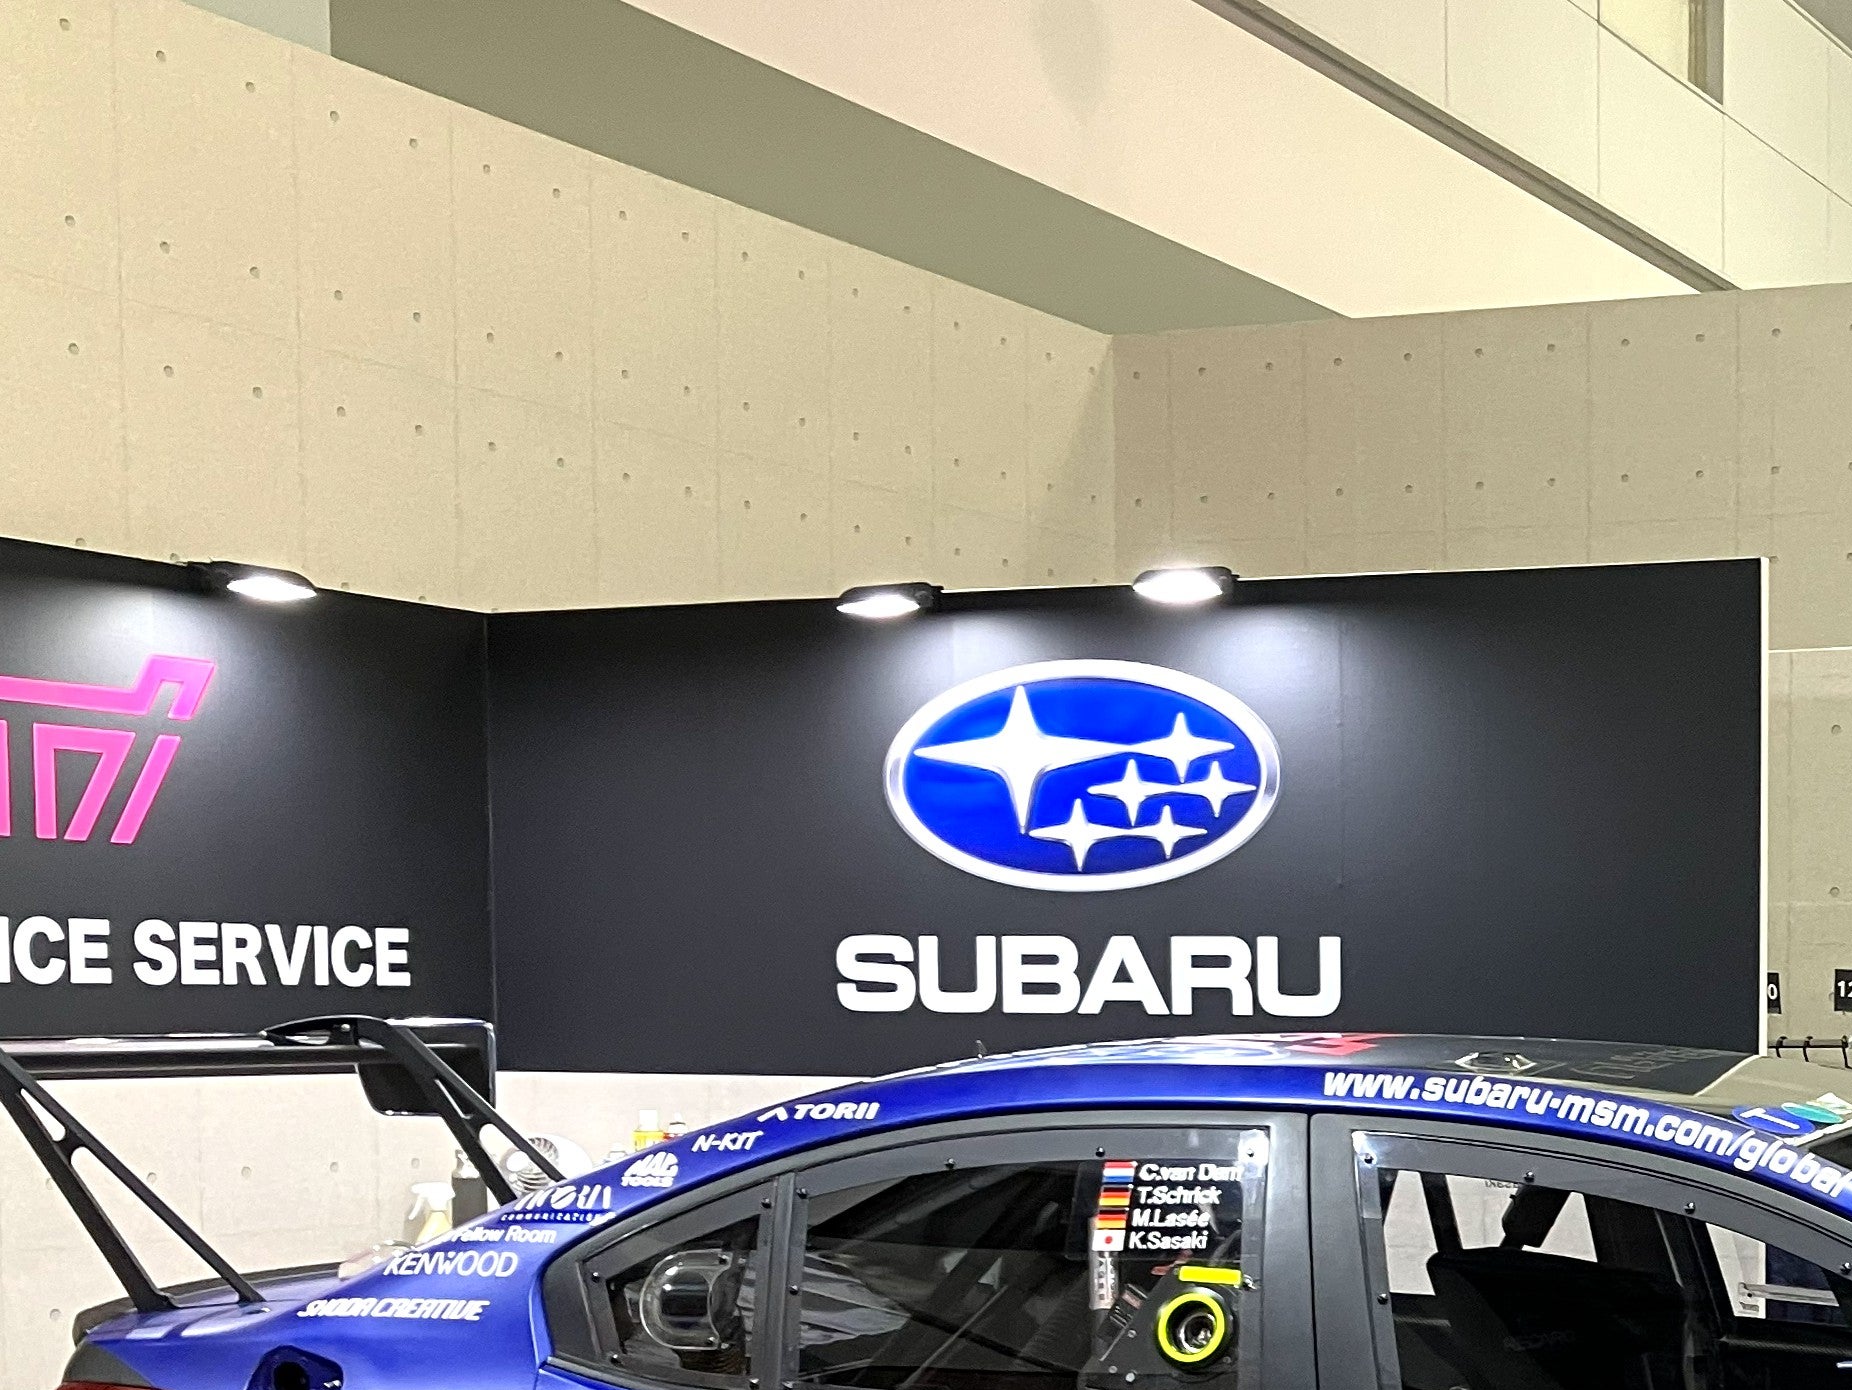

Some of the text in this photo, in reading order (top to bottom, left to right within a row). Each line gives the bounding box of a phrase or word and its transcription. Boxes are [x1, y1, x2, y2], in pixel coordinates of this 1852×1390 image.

[0, 916, 411, 987] CE SERVICE
[836, 934, 1341, 1017] SUBARU
[794, 1102, 880, 1119] TORII
[691, 1130, 764, 1152] N-KIT
[505, 1225, 557, 1244] Room
[1129, 1231, 1209, 1249] K.Sasaki
[383, 1250, 518, 1278] KENWOOD
